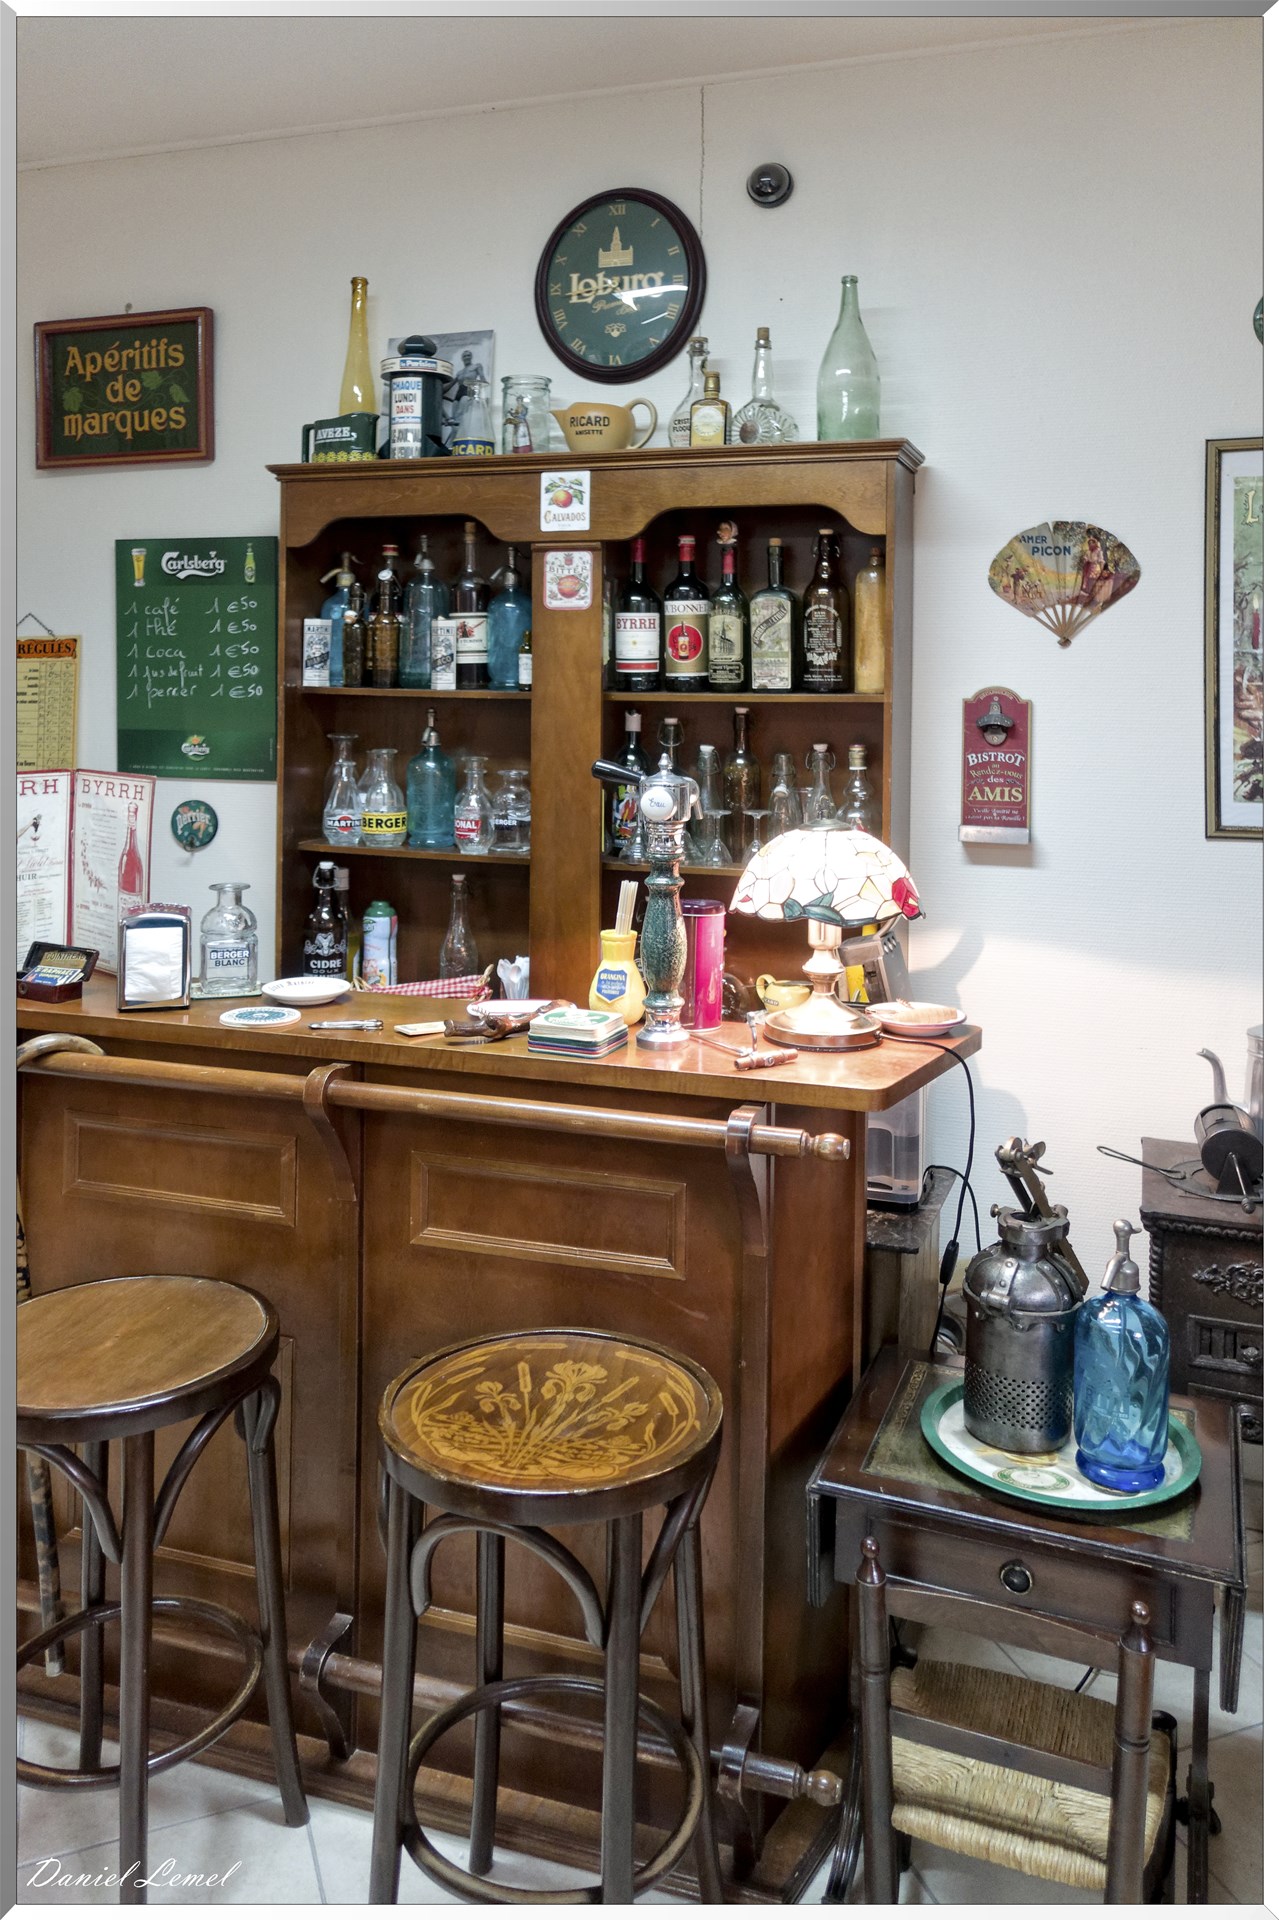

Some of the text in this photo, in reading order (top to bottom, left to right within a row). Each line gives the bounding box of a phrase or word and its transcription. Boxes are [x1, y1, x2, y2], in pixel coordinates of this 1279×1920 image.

[608, 204, 626, 216] XII
[64, 337, 186, 381] Apéritifs
[105, 375, 143, 403] de
[392, 381, 422, 391] CHAQUE
[394, 392, 417, 403] LUNDI
[396, 404, 415, 414] DANS
[62, 405, 188, 440] marques
[569, 415, 611, 428] RICARD
[452, 443, 494, 456] RICARD
[543, 510, 587, 525] CALVADOS
[1019, 535, 1048, 545] AMER
[1031, 545, 1072, 557] PICON
[161, 551, 227, 579] Carlsberg
[548, 564, 589, 575] BITTER
[144, 597, 180, 627] café
[146, 617, 178, 637] thé
[616, 618, 657, 630] BYRRH
[967, 751, 1025, 767] BISTROT
[987, 775, 1004, 783] des
[82, 778, 144, 800] BYRRH
[968, 786, 1023, 802] AMIS
[362, 816, 407, 829] BERGER
[210, 950, 249, 959] BERGER
[214, 959, 245, 967] BLANC
[309, 959, 342, 970] CIDRE
